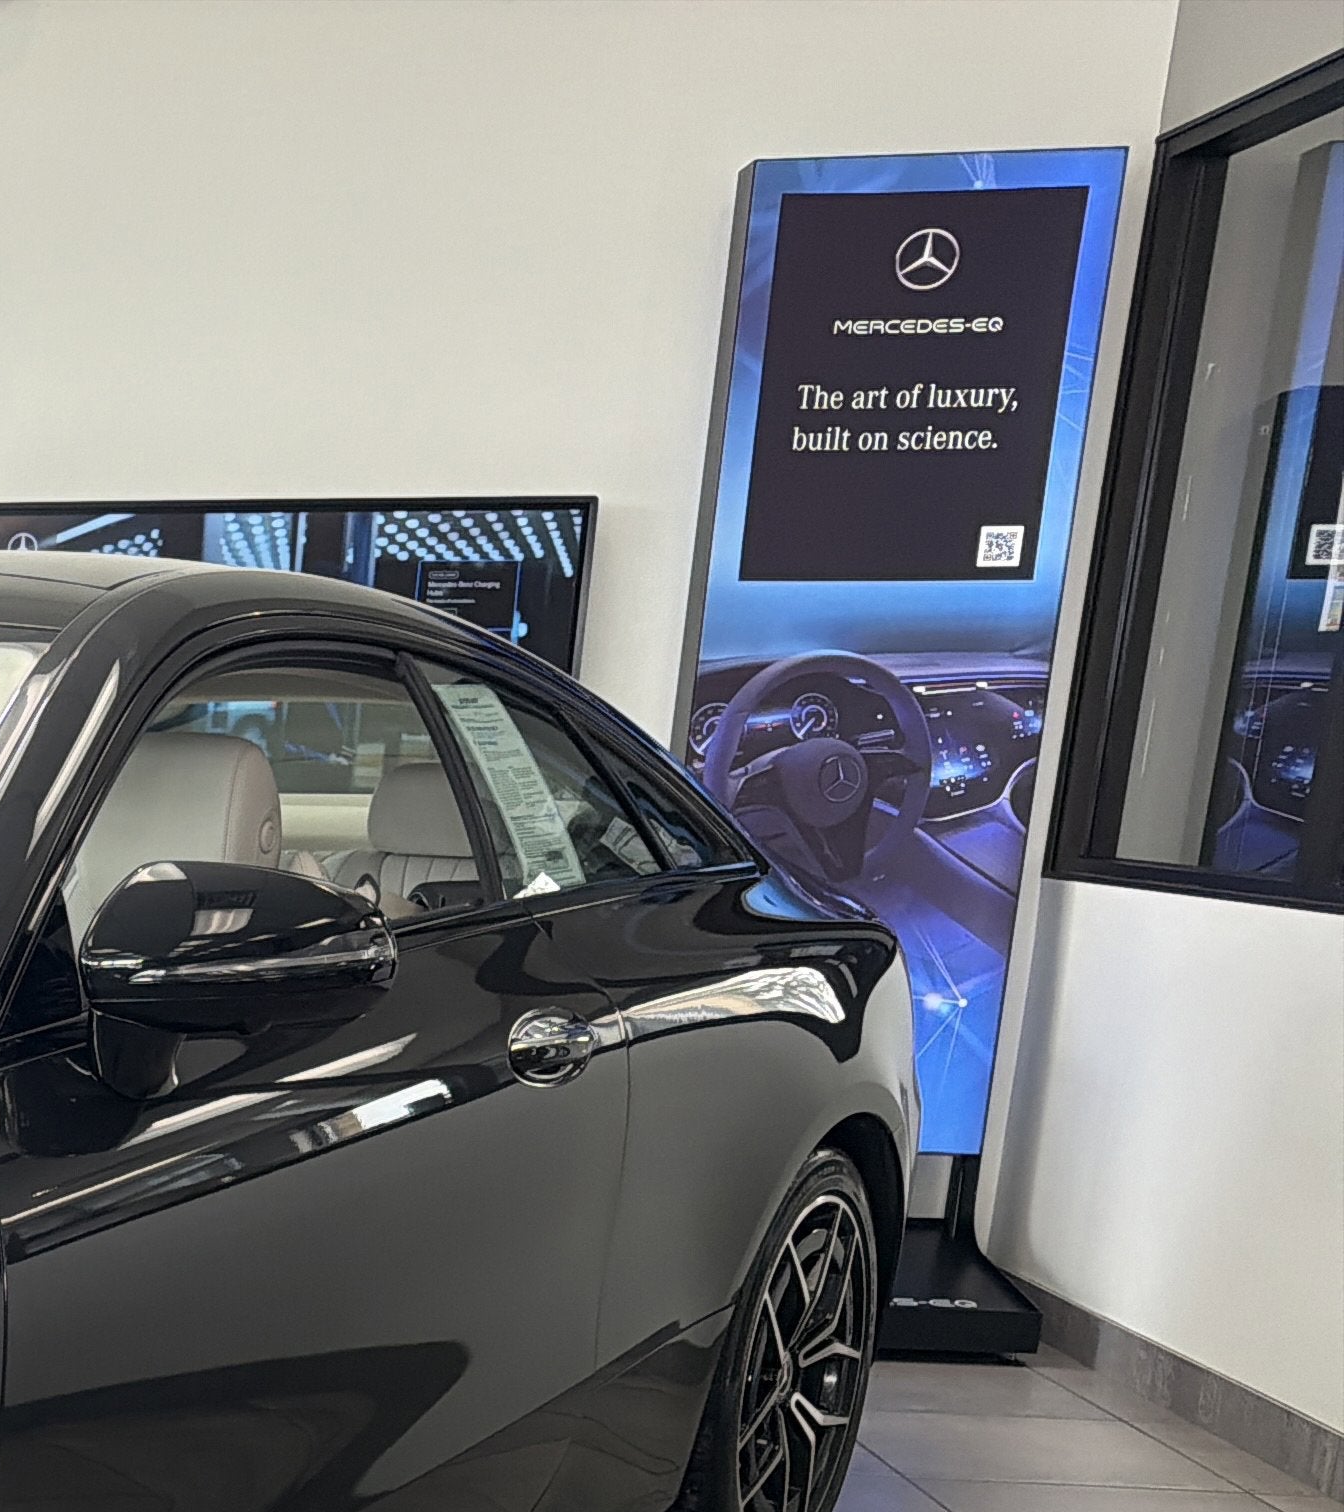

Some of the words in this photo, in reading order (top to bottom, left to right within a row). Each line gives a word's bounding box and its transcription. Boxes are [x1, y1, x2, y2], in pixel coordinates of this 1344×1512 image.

[833, 316, 1004, 335] MERCEDES-EQ
[798, 384, 844, 409] The
[851, 385, 889, 409] art
[896, 383, 923, 409] of
[928, 383, 1018, 413] luxury,
[792, 426, 851, 451] built
[858, 431, 889, 451] on
[897, 425, 998, 450] science.
